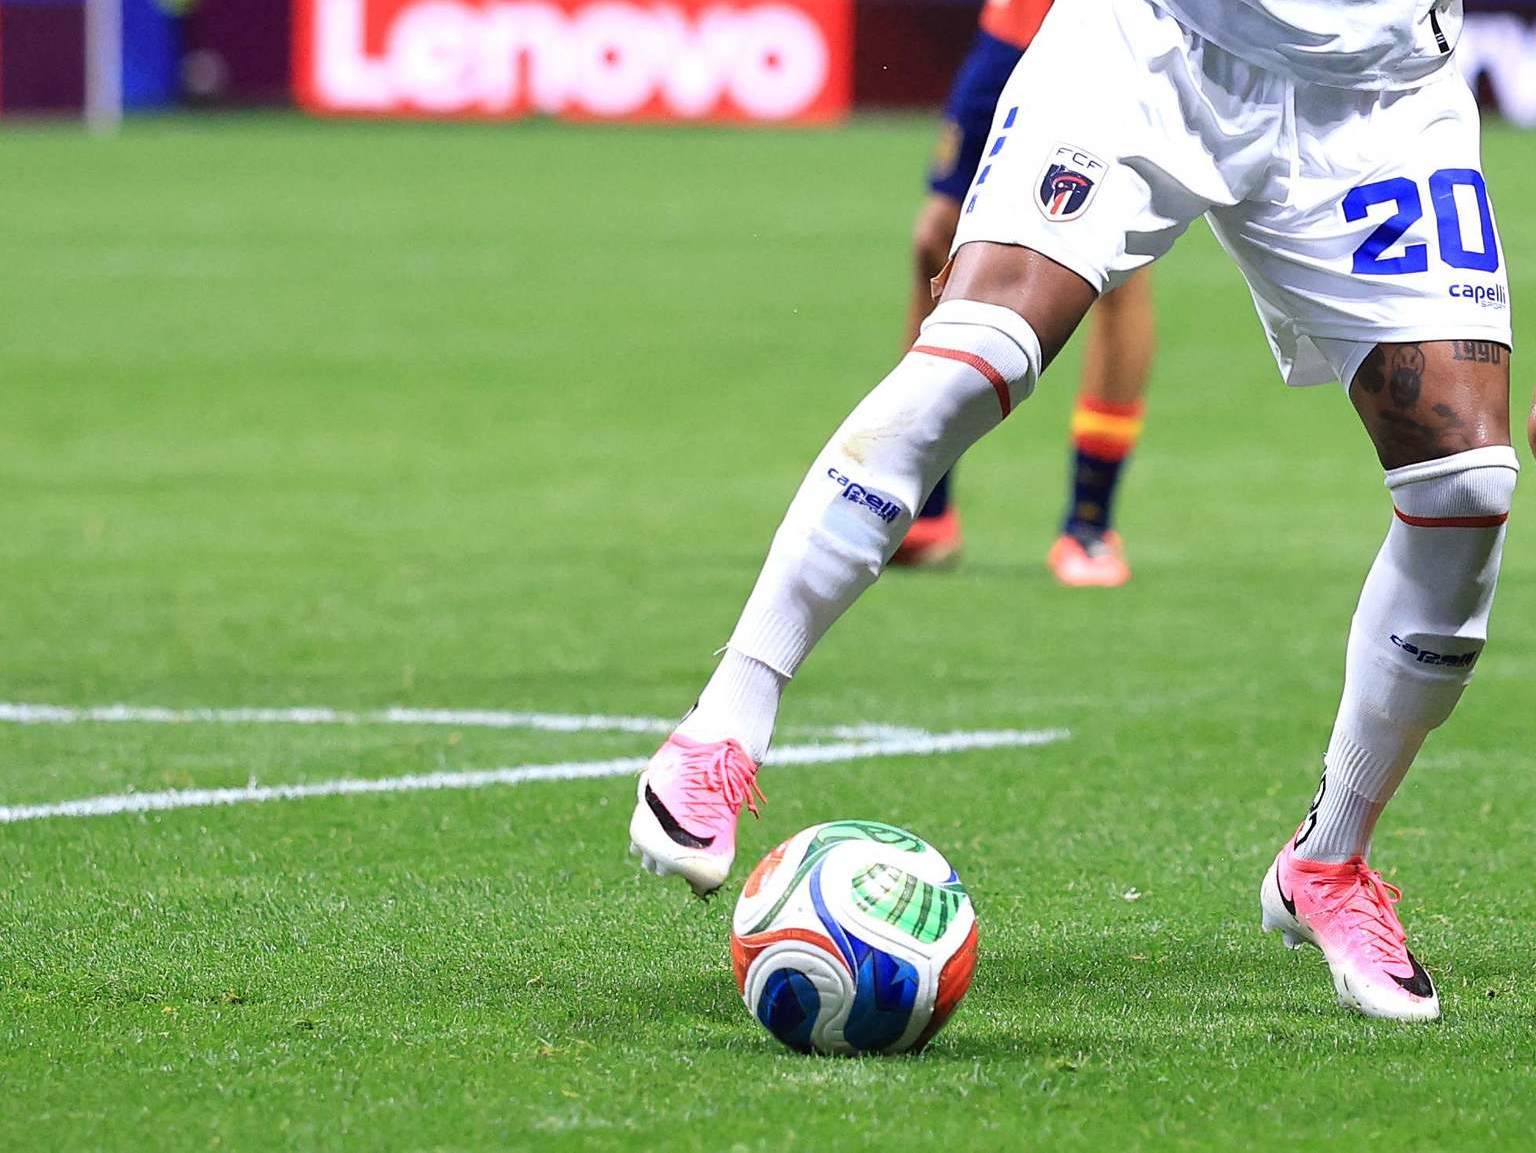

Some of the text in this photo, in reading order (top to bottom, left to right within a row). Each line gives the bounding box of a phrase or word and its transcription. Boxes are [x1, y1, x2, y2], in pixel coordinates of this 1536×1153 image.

[1056, 147, 1103, 169] FCF
[1342, 168, 1499, 275] 20
[1449, 283, 1506, 304] capelli
[827, 467, 902, 524] capelli
